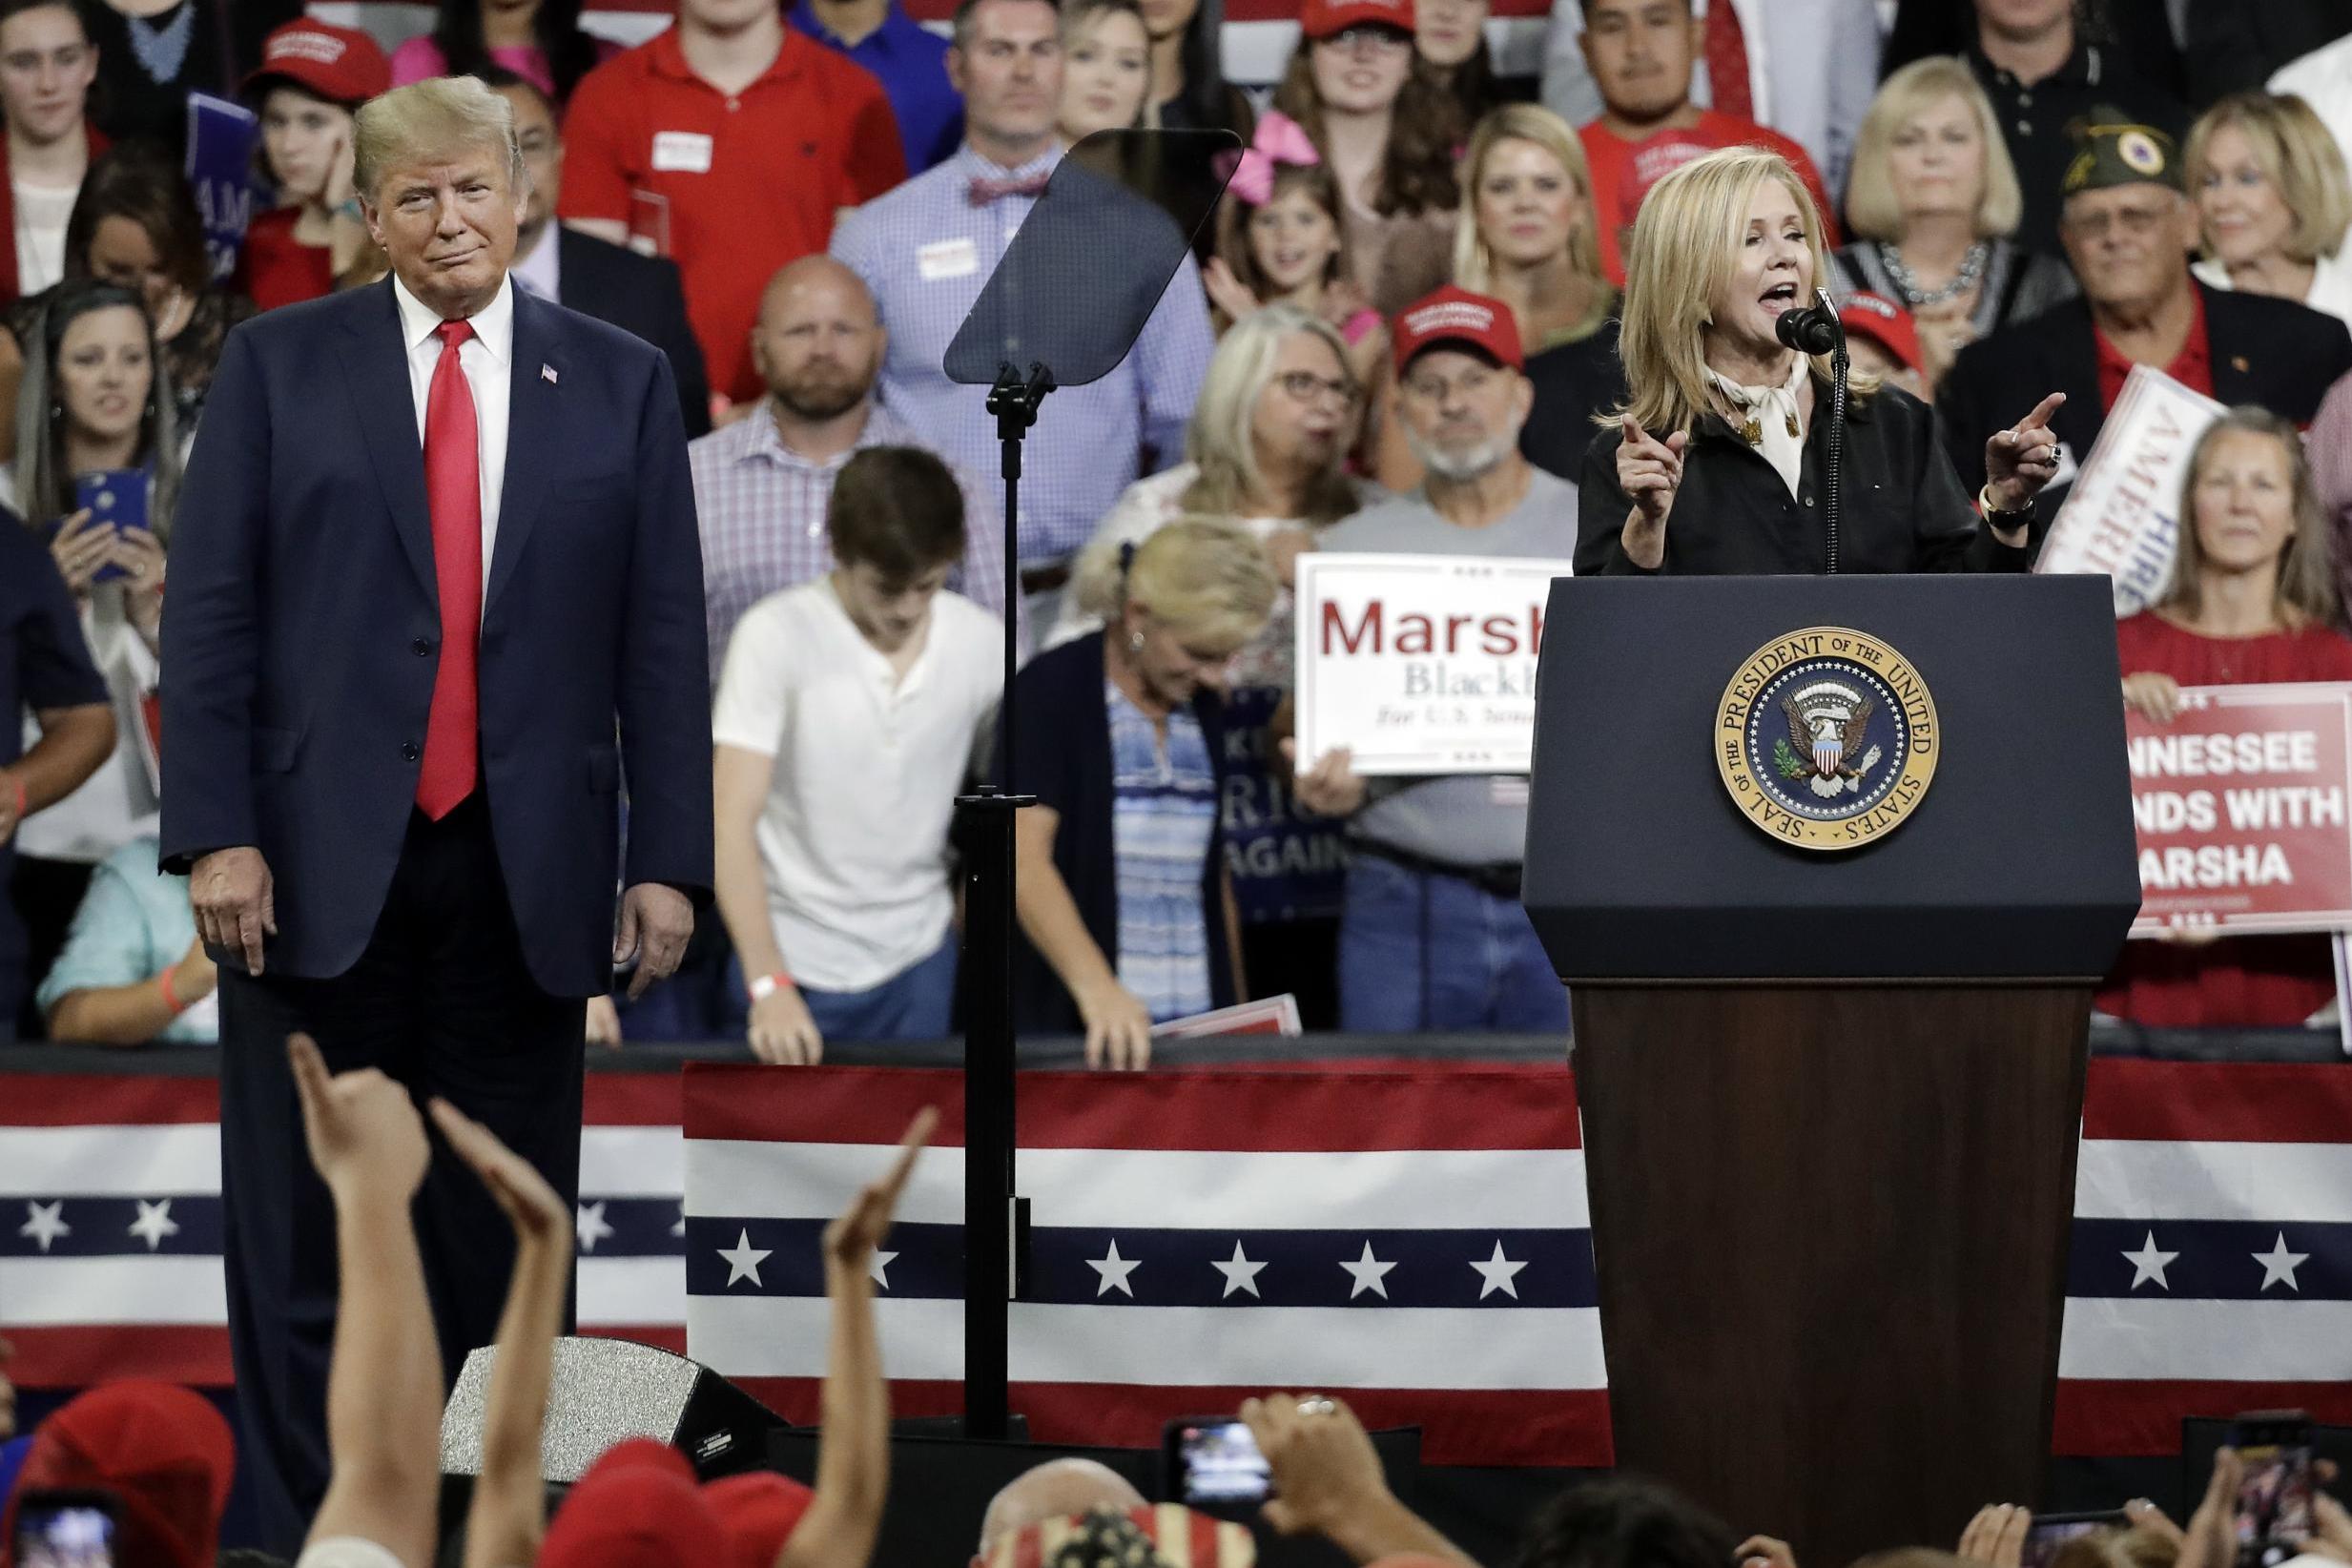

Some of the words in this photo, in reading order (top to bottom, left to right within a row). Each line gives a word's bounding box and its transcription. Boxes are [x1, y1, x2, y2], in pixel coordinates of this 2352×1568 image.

[1831, 638, 1852, 652] OF
[1856, 643, 1883, 666] THE
[1723, 635, 1824, 731] PRESIDENT
[1888, 664, 1931, 754] UNITED
[1725, 739, 1742, 771] THE
[1733, 774, 1750, 793] OF
[1845, 774, 1922, 839] STATES
[1749, 791, 1805, 838] SEAL
[2224, 785, 2343, 830] WITH
[2138, 842, 2294, 890] ARSHA
